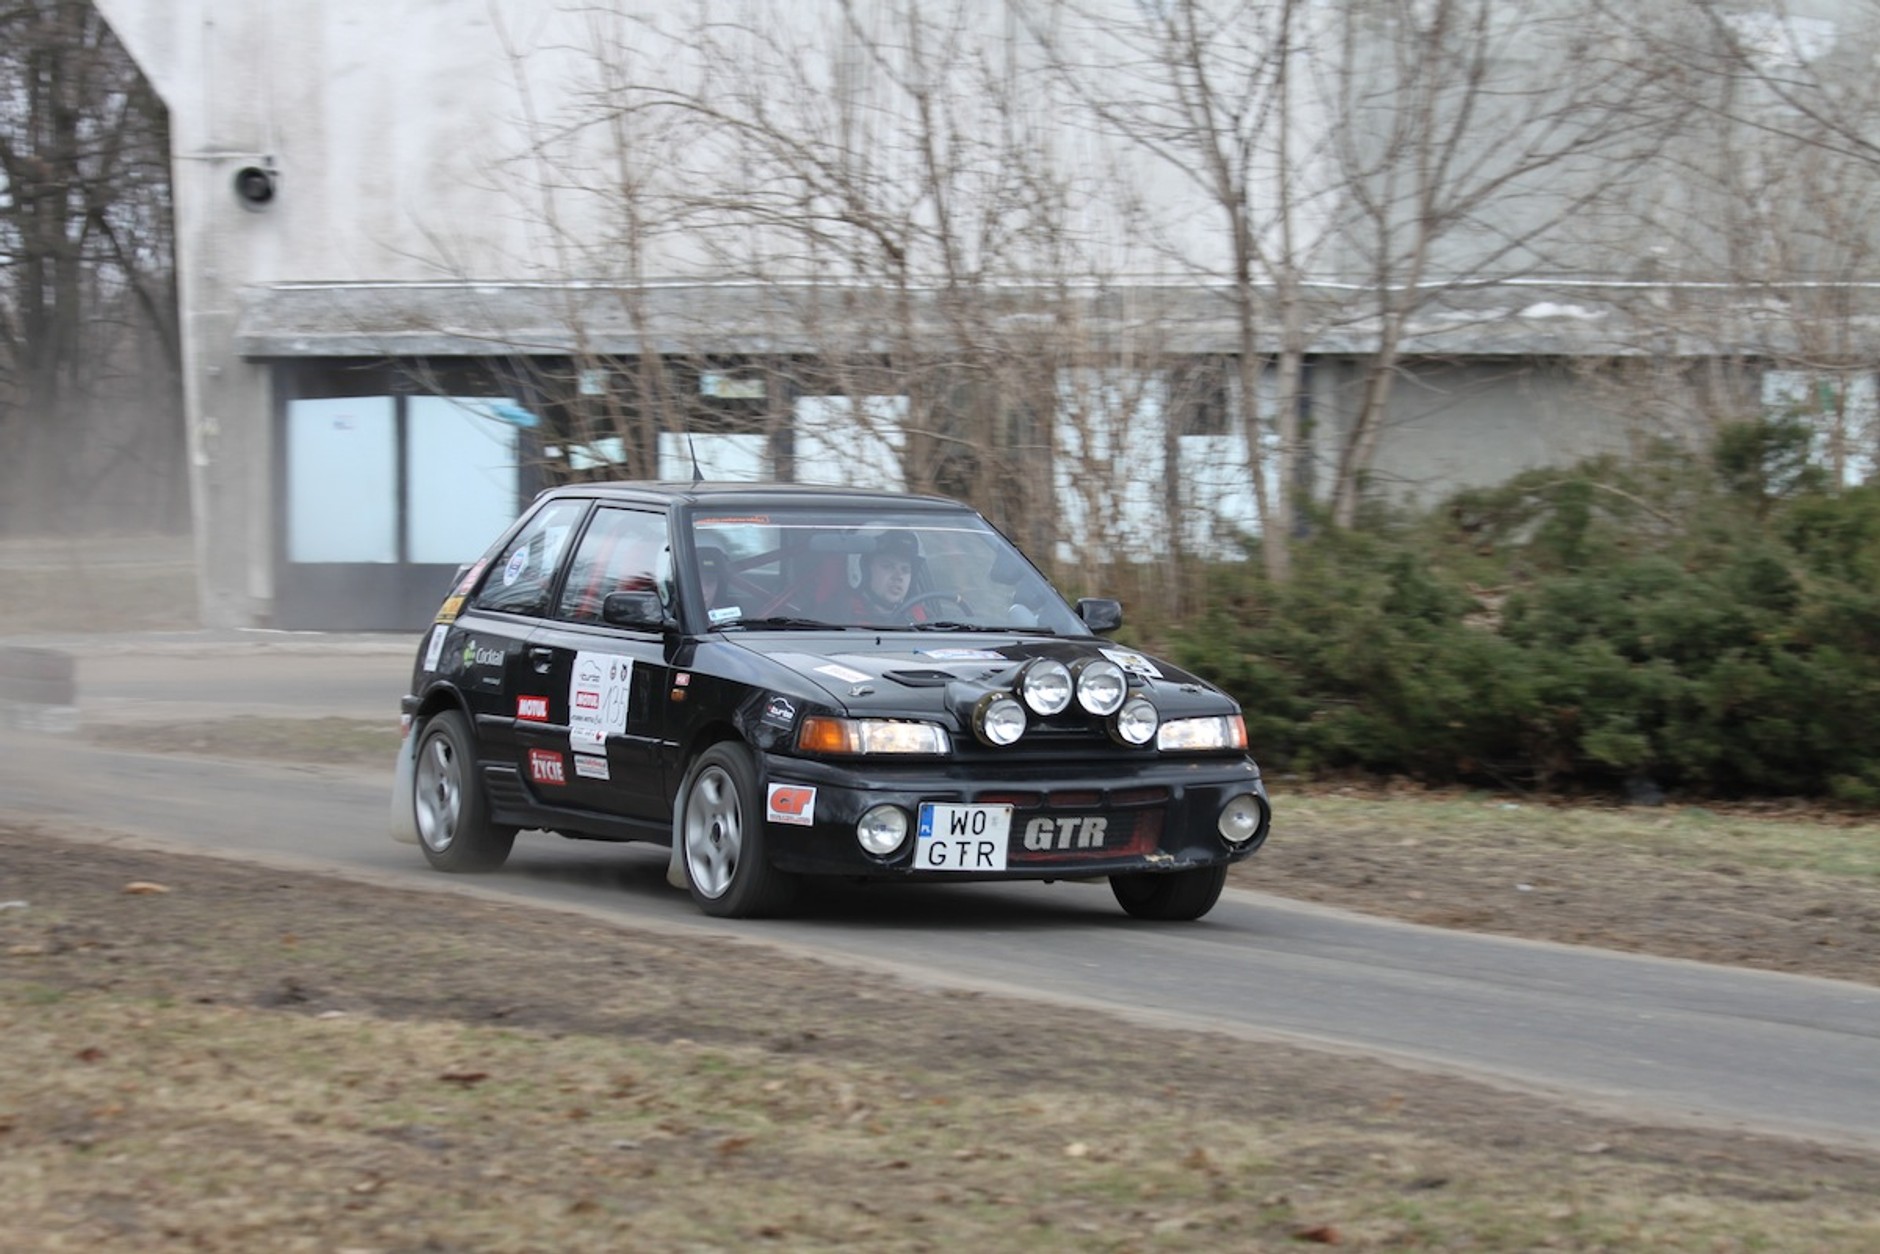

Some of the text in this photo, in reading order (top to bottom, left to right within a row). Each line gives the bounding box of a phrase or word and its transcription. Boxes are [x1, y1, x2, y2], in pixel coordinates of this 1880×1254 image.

[518, 699, 548, 717] MOTUL
[950, 810, 986, 836] WO
[1023, 816, 1108, 851] GTR
[928, 841, 995, 867] GTR
